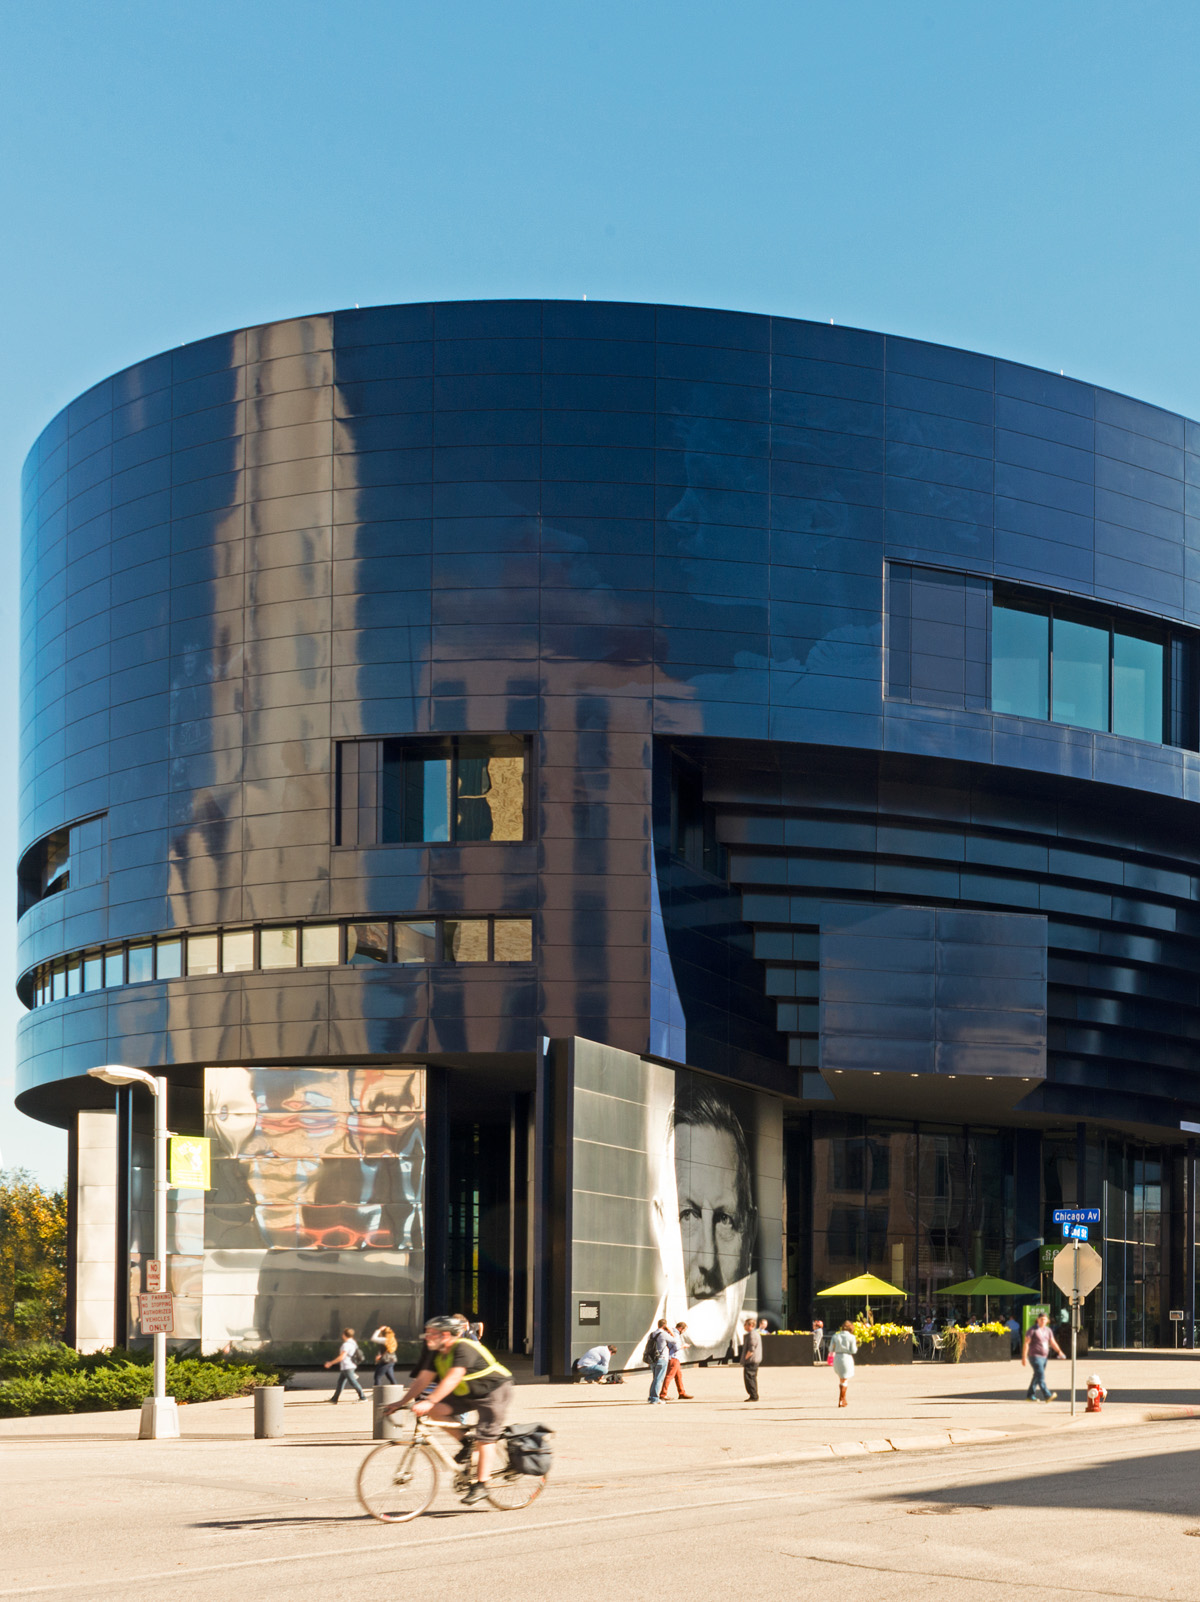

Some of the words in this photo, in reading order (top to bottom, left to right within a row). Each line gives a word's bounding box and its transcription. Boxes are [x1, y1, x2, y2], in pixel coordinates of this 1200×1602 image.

[1055, 1211, 1085, 1222] Chicago
[1087, 1211, 1098, 1220] Av
[1064, 1225, 1069, 1235] S
[1081, 1228, 1087, 1239] St
[150, 1264, 158, 1272] NO
[151, 1301, 172, 1309] STOPPING
[143, 1308, 172, 1316] AUTHORIZED
[145, 1315, 170, 1323] VEHICLES
[148, 1323, 168, 1332] ONLY
